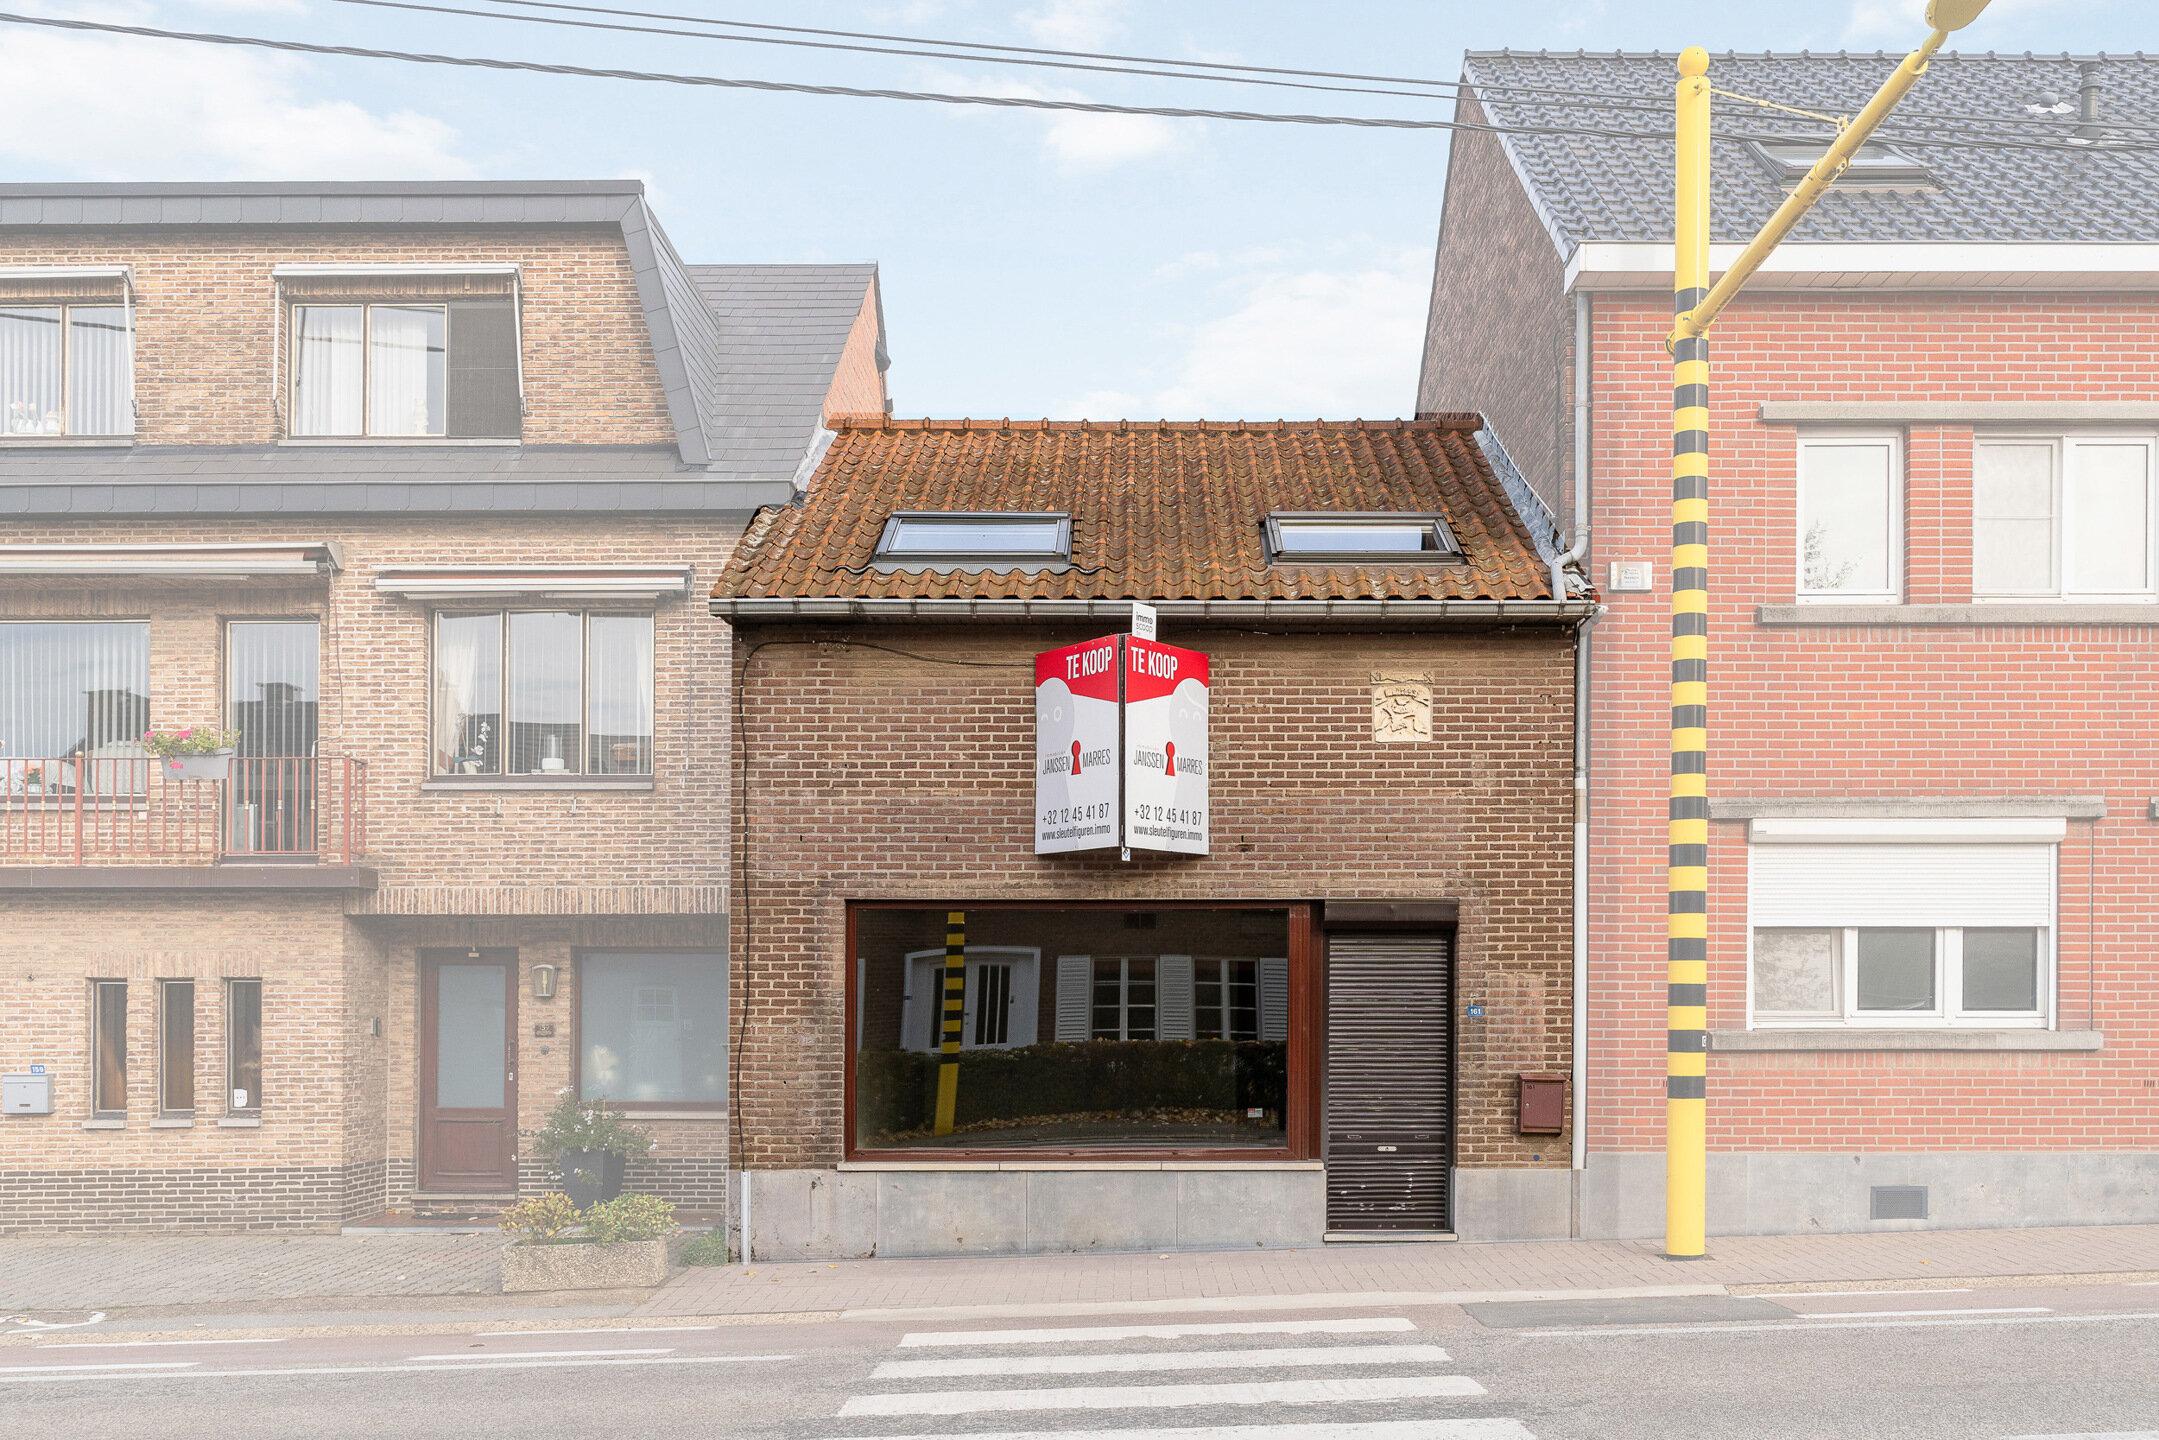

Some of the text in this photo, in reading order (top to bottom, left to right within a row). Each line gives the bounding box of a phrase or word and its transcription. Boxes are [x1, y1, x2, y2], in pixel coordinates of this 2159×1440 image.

[1136, 611, 1153, 625] immo
[1066, 646, 1113, 680] TE KOOP
[1130, 646, 1178, 680] TE KOOP
[1042, 748, 1111, 775] JANSSEN MARRES
[1133, 750, 1203, 776] JANSSEN MARRES
[1042, 802, 1110, 825] +32 12 45 41 87
[1134, 803, 1202, 826] +32 12 45 41 87
[1041, 823, 1111, 841] www.sleutelfiguren.immo
[1133, 824, 1203, 842] www.sleutelfiguren.immo
